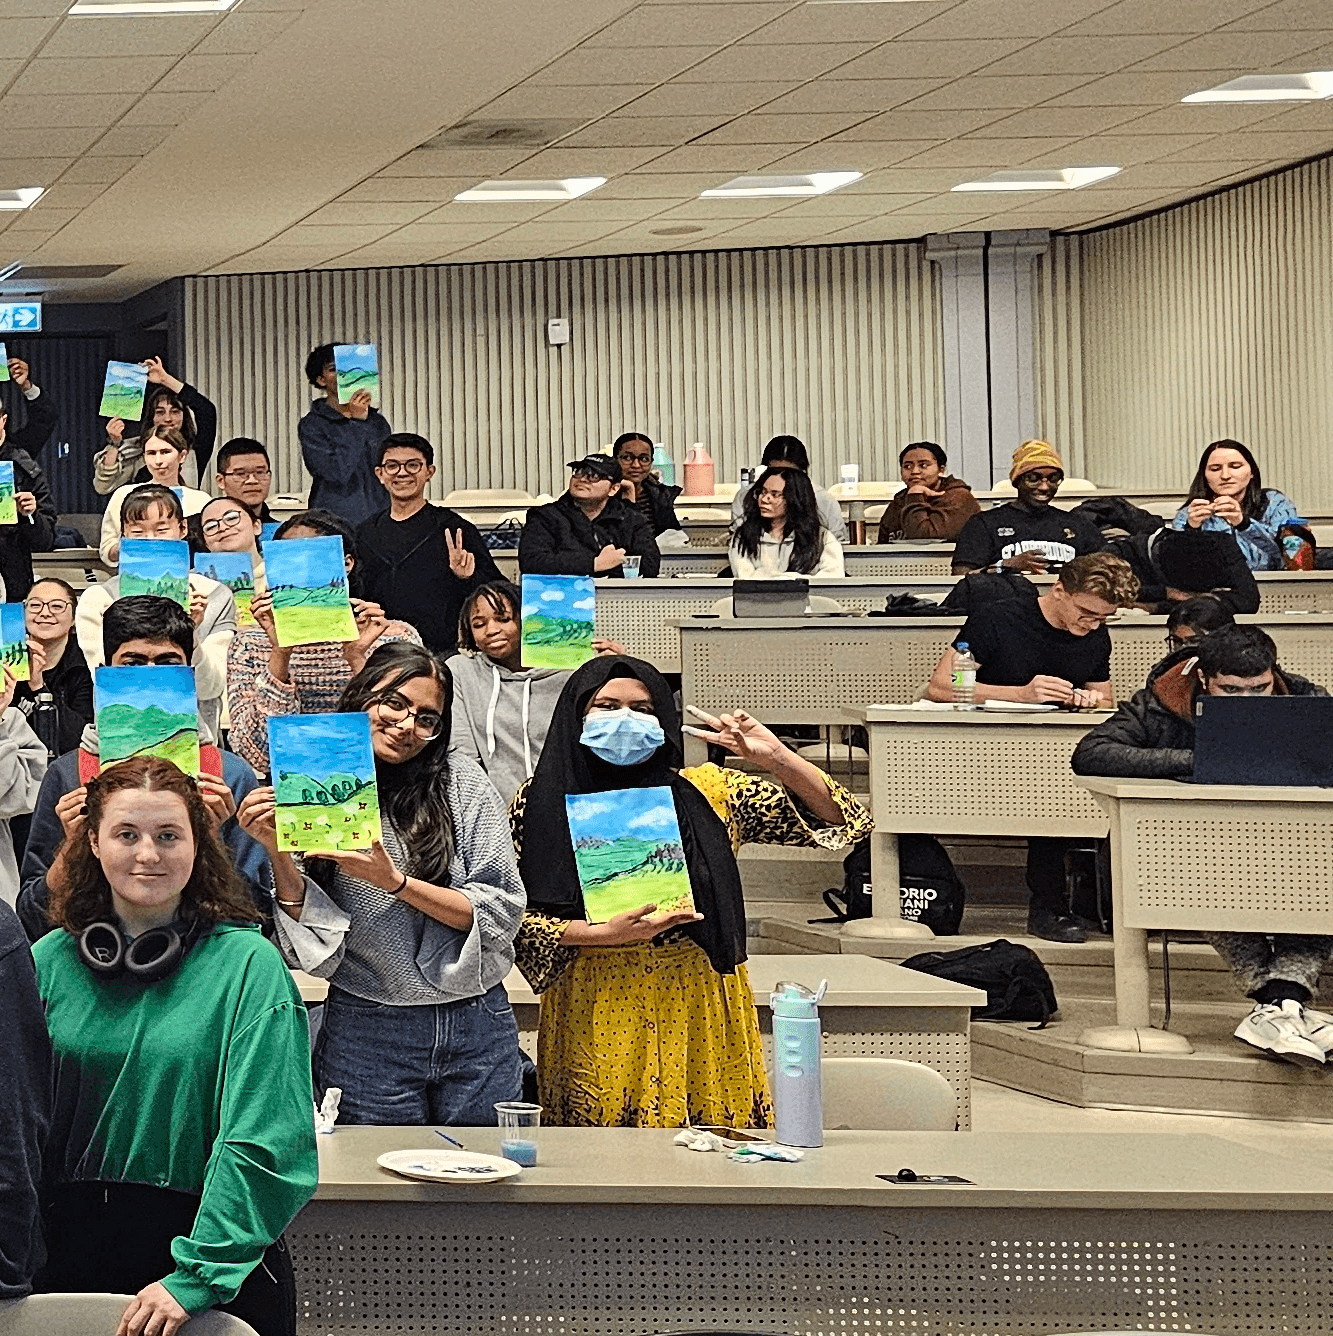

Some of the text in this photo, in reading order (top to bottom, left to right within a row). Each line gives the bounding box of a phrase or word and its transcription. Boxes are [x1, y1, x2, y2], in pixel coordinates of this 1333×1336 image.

[862, 883, 937, 901] EORIO
[900, 899, 929, 910] ANI
[95, 947, 113, 961] R
